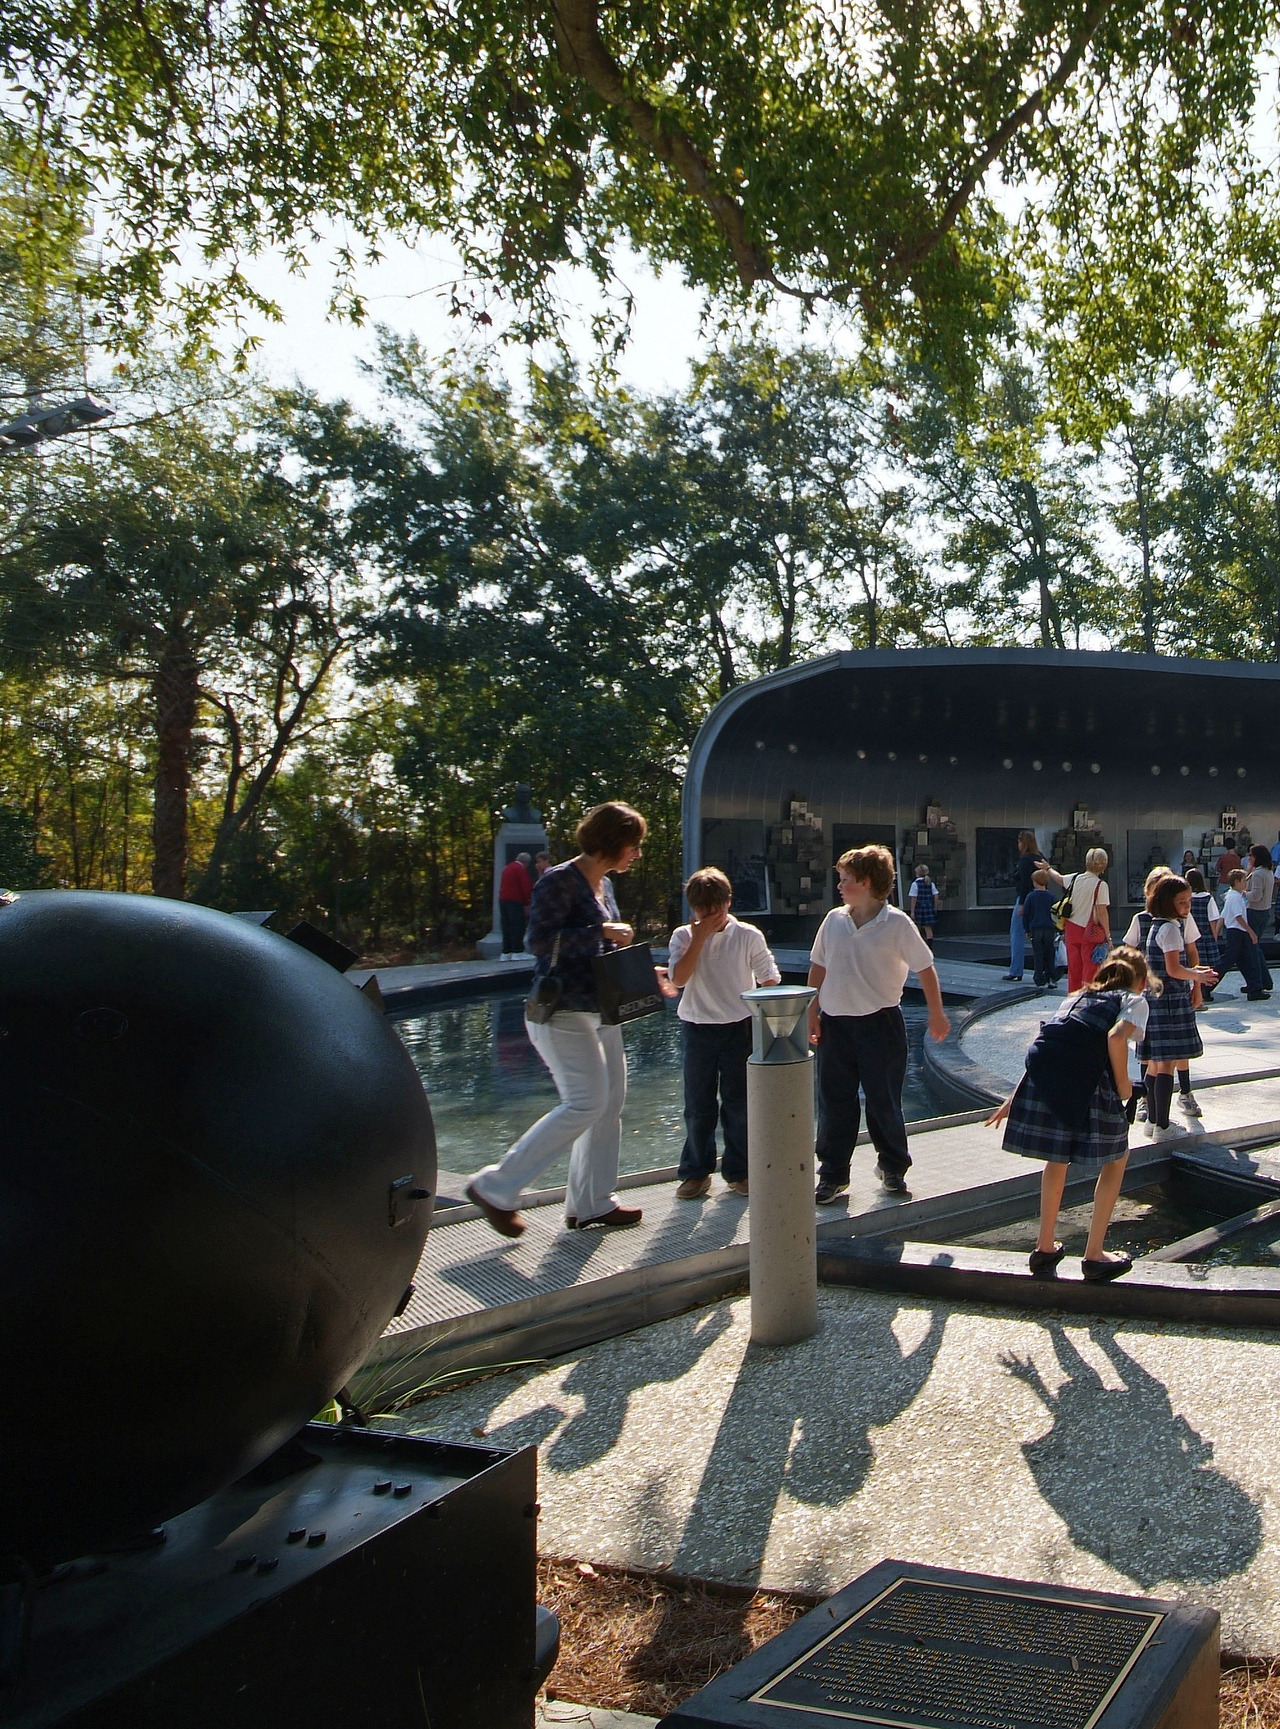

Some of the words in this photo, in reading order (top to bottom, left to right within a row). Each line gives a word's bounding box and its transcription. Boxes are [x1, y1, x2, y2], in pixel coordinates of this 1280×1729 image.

[825, 1694, 855, 1703] MEN
[854, 1699, 888, 1709] IRON
[888, 1705, 918, 1714] AND
[918, 1710, 956, 1720] SHIPS
[957, 1716, 1016, 1729] WOODEN
